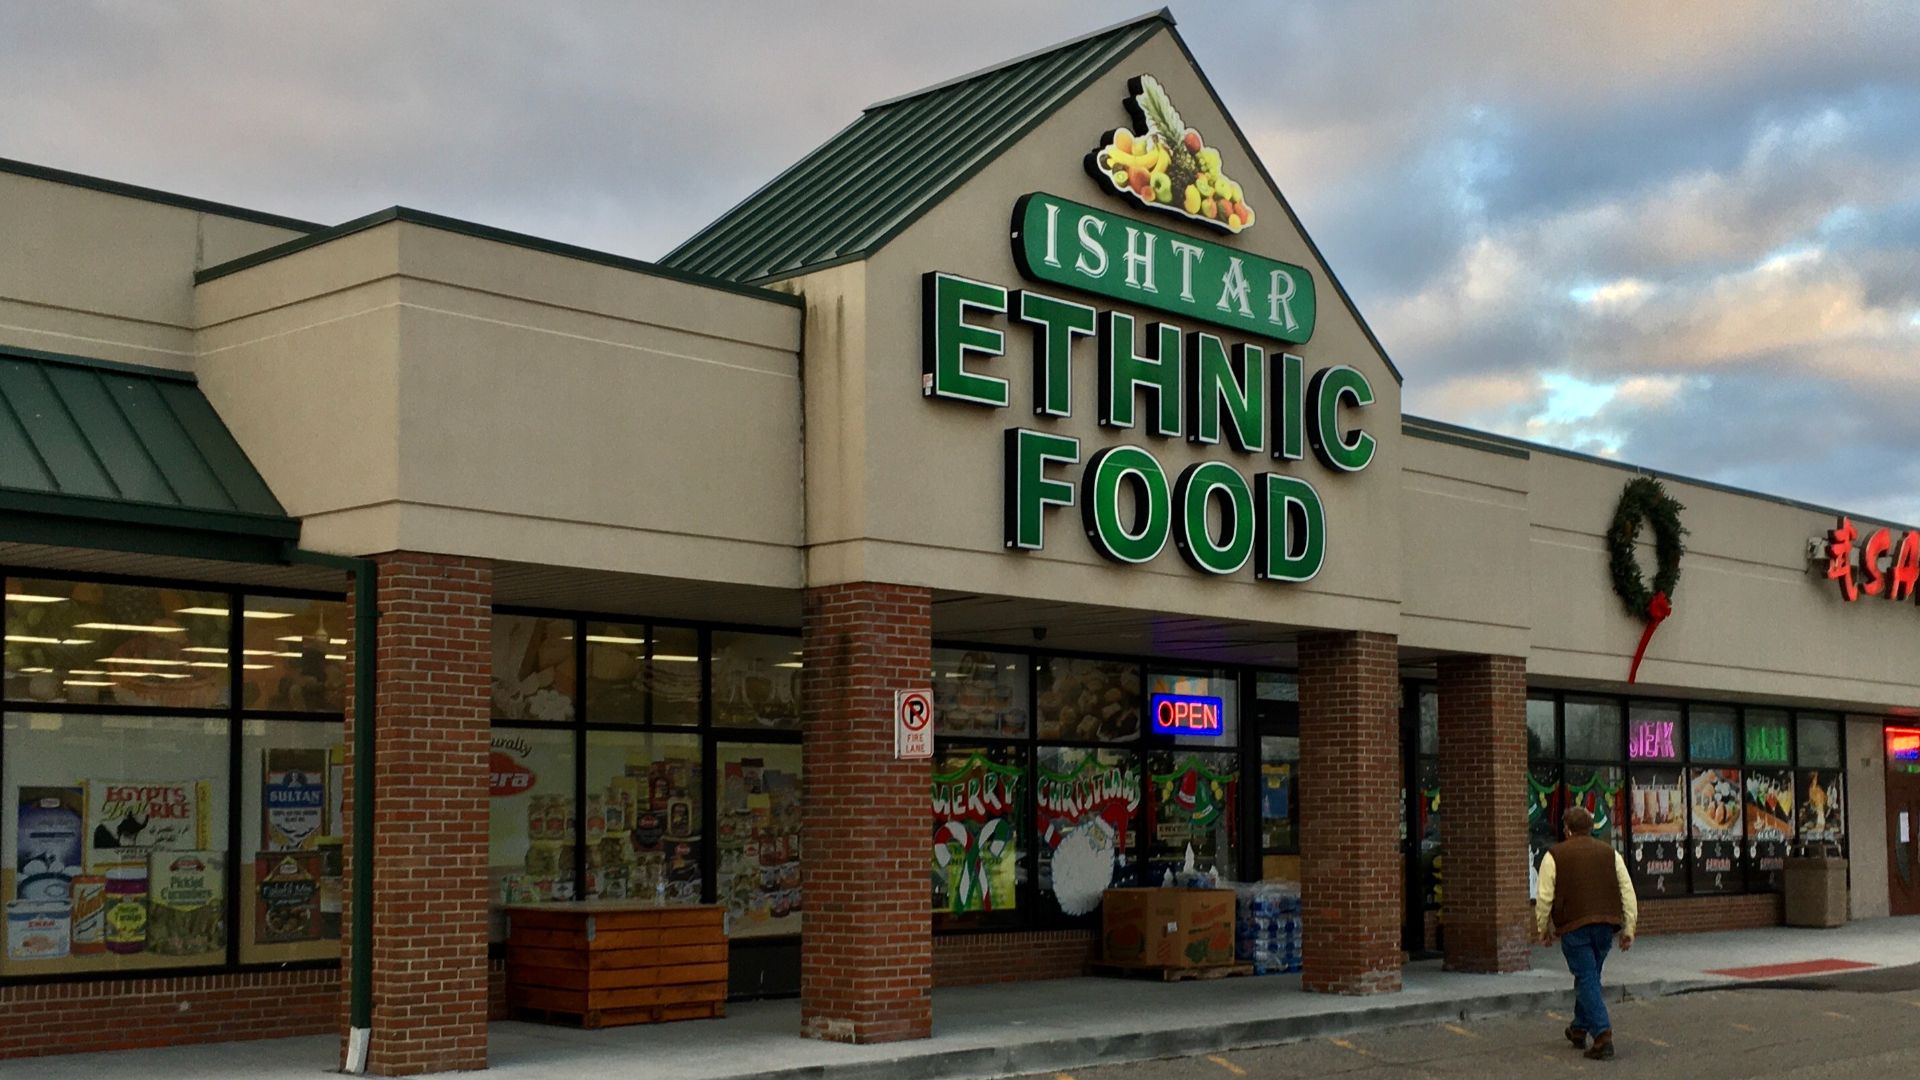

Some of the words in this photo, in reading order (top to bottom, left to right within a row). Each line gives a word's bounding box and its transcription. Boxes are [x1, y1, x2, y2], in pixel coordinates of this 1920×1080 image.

[1043, 202, 1300, 334] ISHTAR
[923, 271, 1378, 473] ETHNIC
[1004, 427, 1327, 582] FOOD
[1157, 700, 1218, 729] OPEN
[905, 743, 926, 754] LANE
[906, 733, 924, 743] FIRE
[1630, 721, 1675, 758] STEAK
[269, 789, 320, 803] SULTAN
[931, 771, 1019, 817] MERRY
[1037, 768, 1141, 817] CHRISTMAS
[148, 802, 190, 819] RICE
